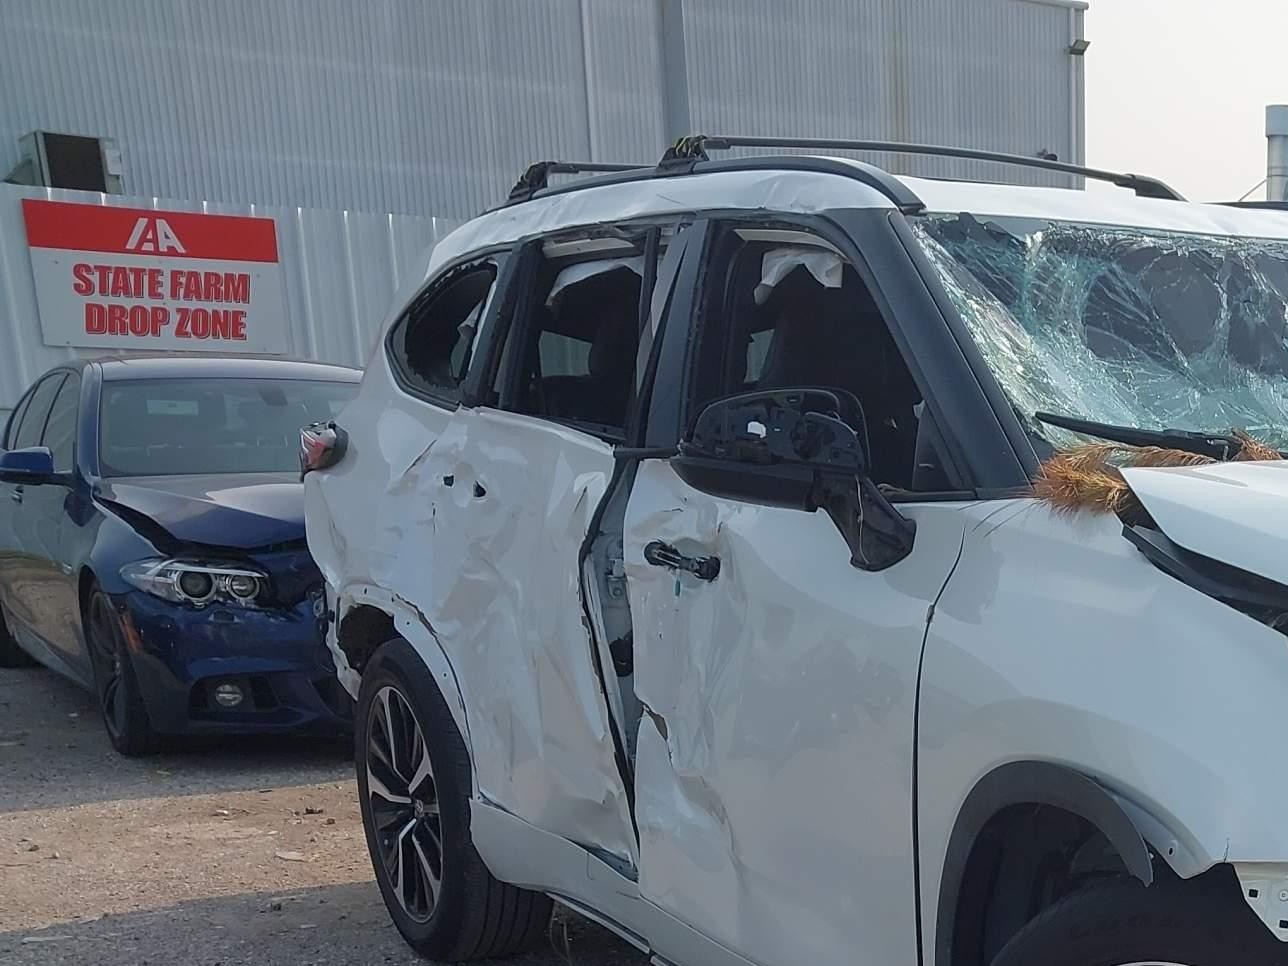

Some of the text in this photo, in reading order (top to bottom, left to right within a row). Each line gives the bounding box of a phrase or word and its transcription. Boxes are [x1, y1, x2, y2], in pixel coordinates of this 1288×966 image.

[72, 263, 251, 304] STATE FARM
[85, 302, 248, 341] DROP ZONE
